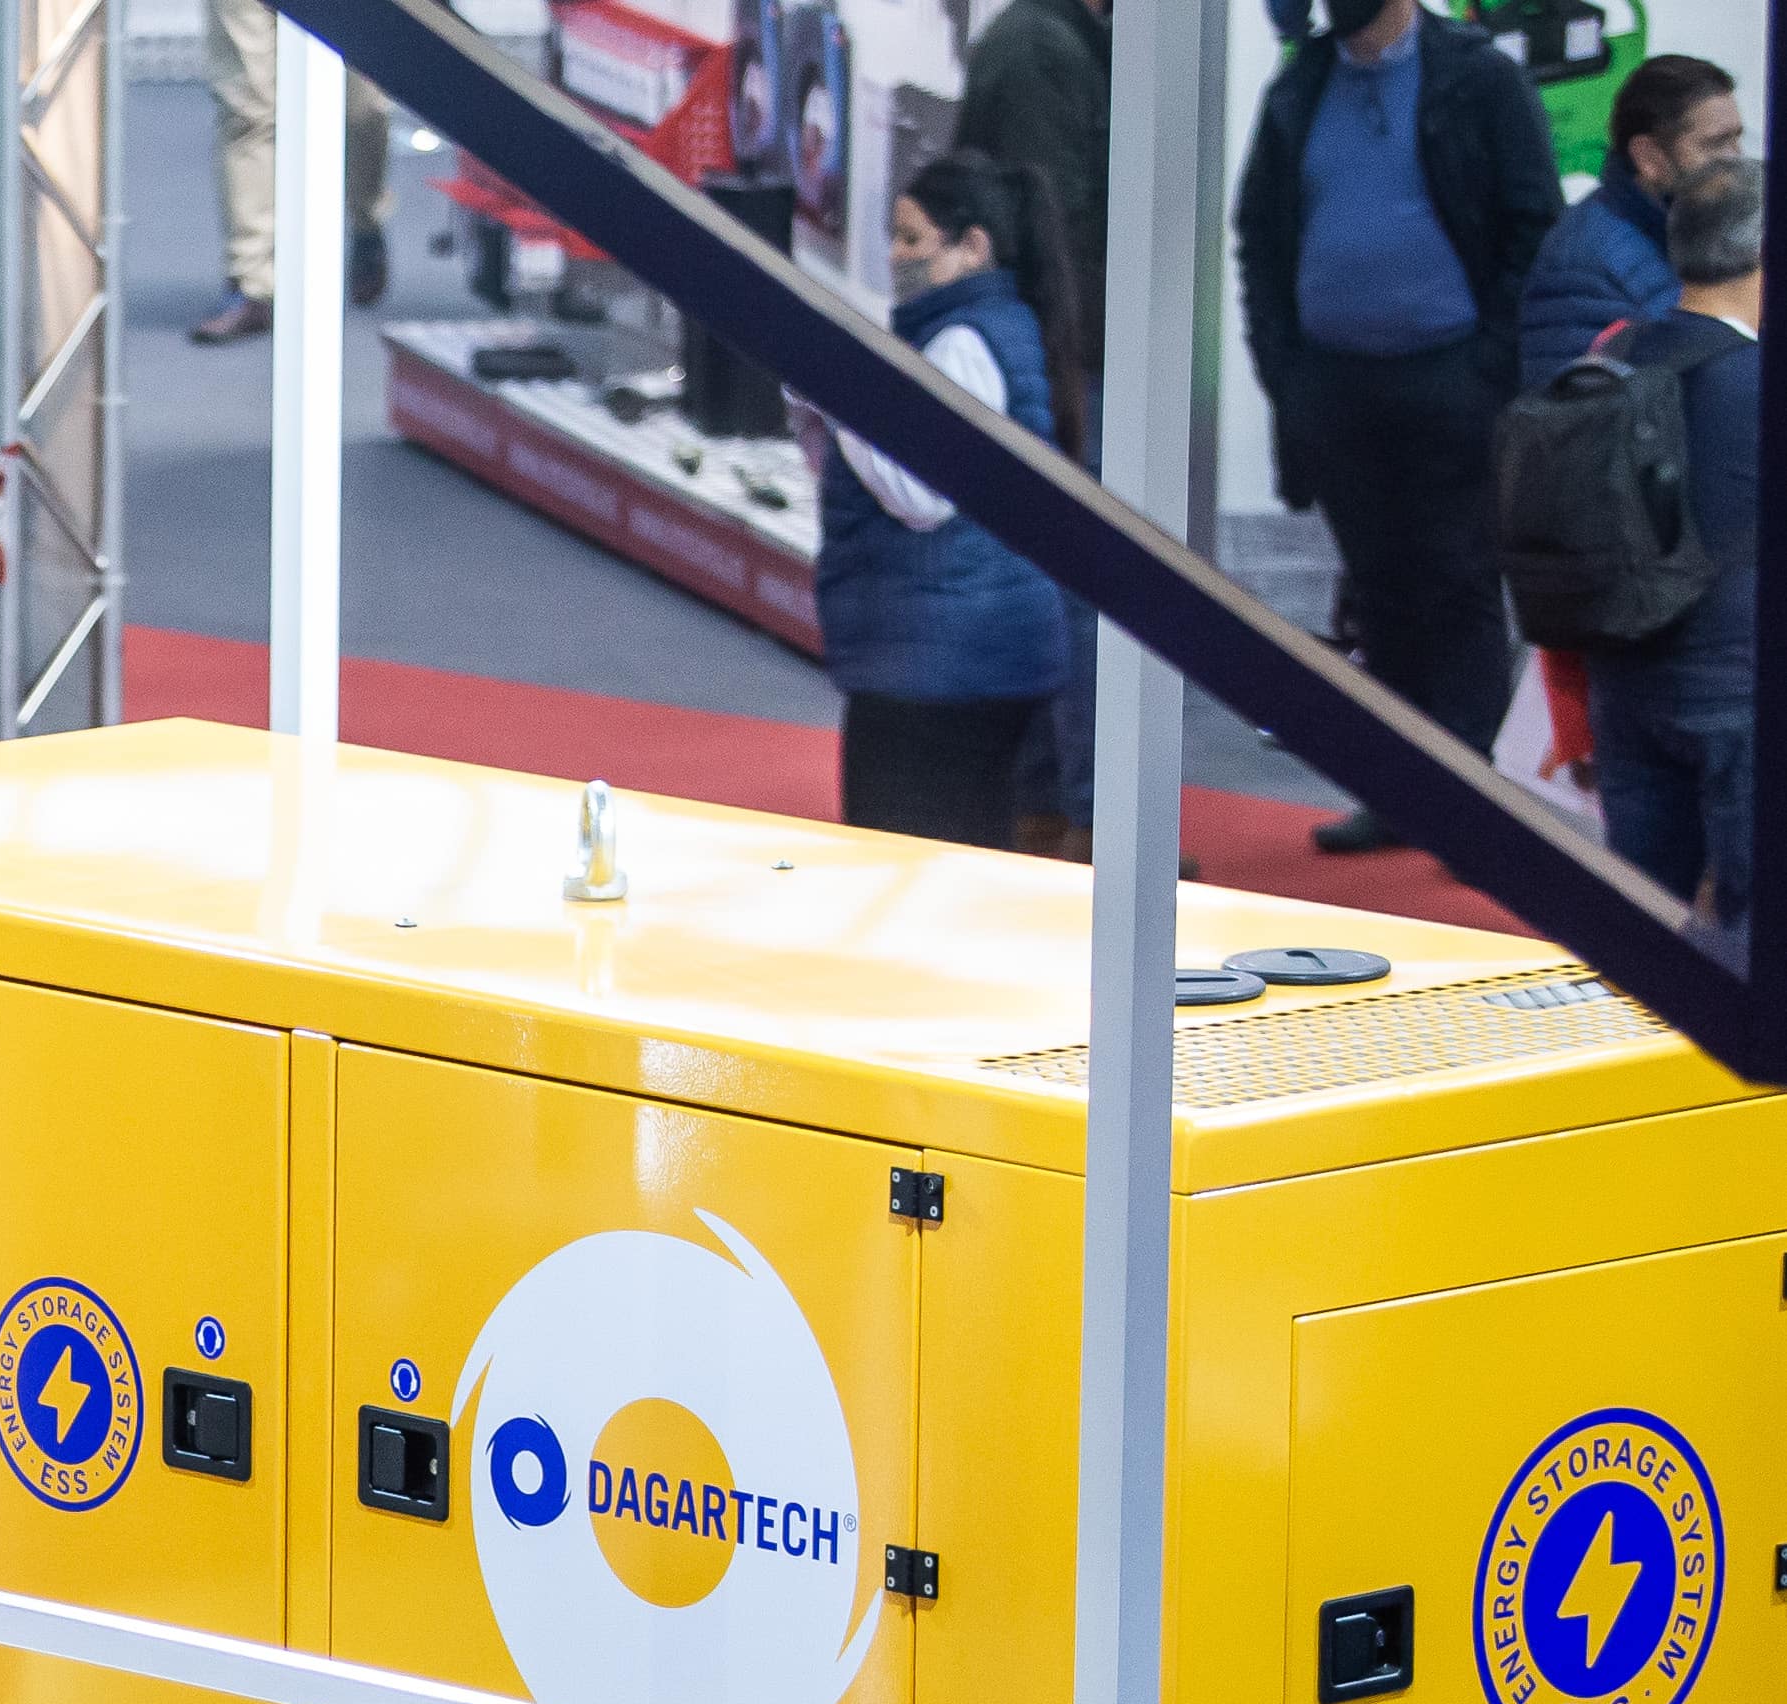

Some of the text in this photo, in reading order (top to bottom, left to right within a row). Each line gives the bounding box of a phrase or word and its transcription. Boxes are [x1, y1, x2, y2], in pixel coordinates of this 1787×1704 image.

[17, 1295, 112, 1347] STORAGE
[102, 1350, 132, 1472] SYSTEM
[40, 1461, 89, 1495] ESS
[587, 1459, 840, 1565] DAGARTECH
[1526, 1437, 1678, 1516] STORAGE
[1656, 1491, 1706, 1681] SYSTEM
